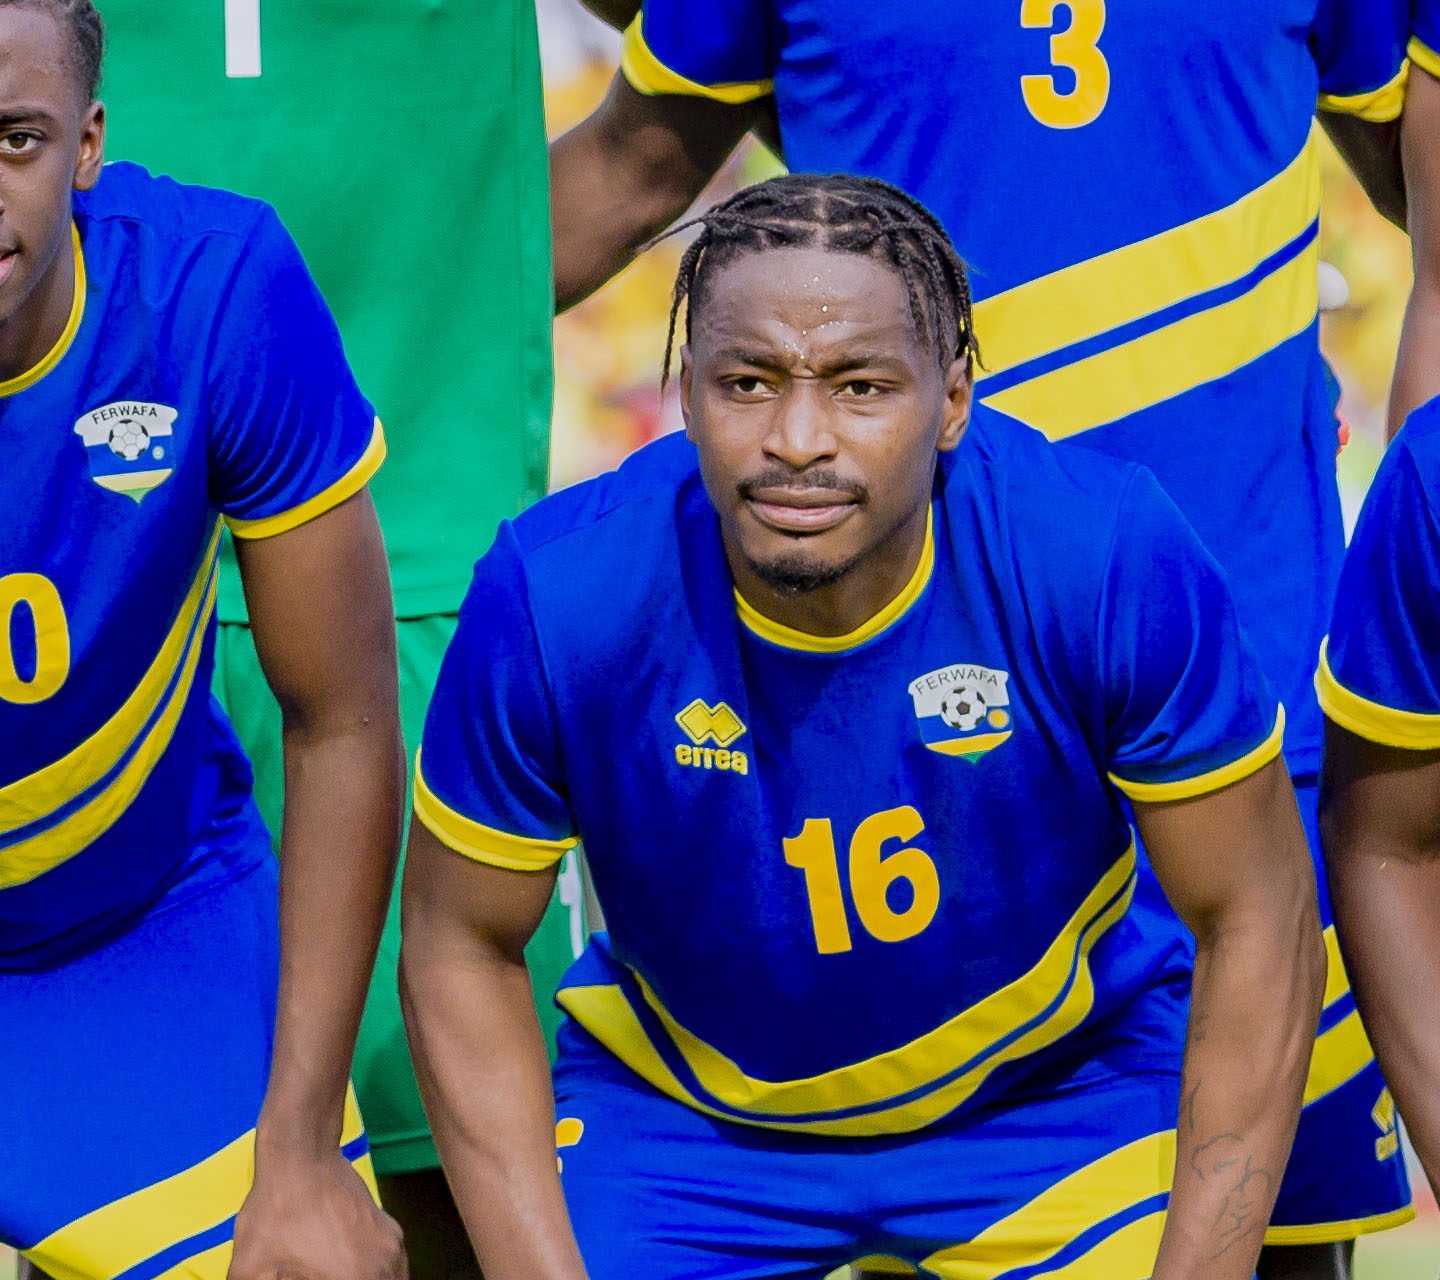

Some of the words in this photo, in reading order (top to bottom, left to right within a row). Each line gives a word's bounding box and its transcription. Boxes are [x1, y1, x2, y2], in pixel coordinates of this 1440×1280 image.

[92, 405, 158, 425] FERWAFA
[915, 667, 998, 695] FERWAFA
[675, 742, 749, 776] errea
[782, 805, 941, 955] 16
